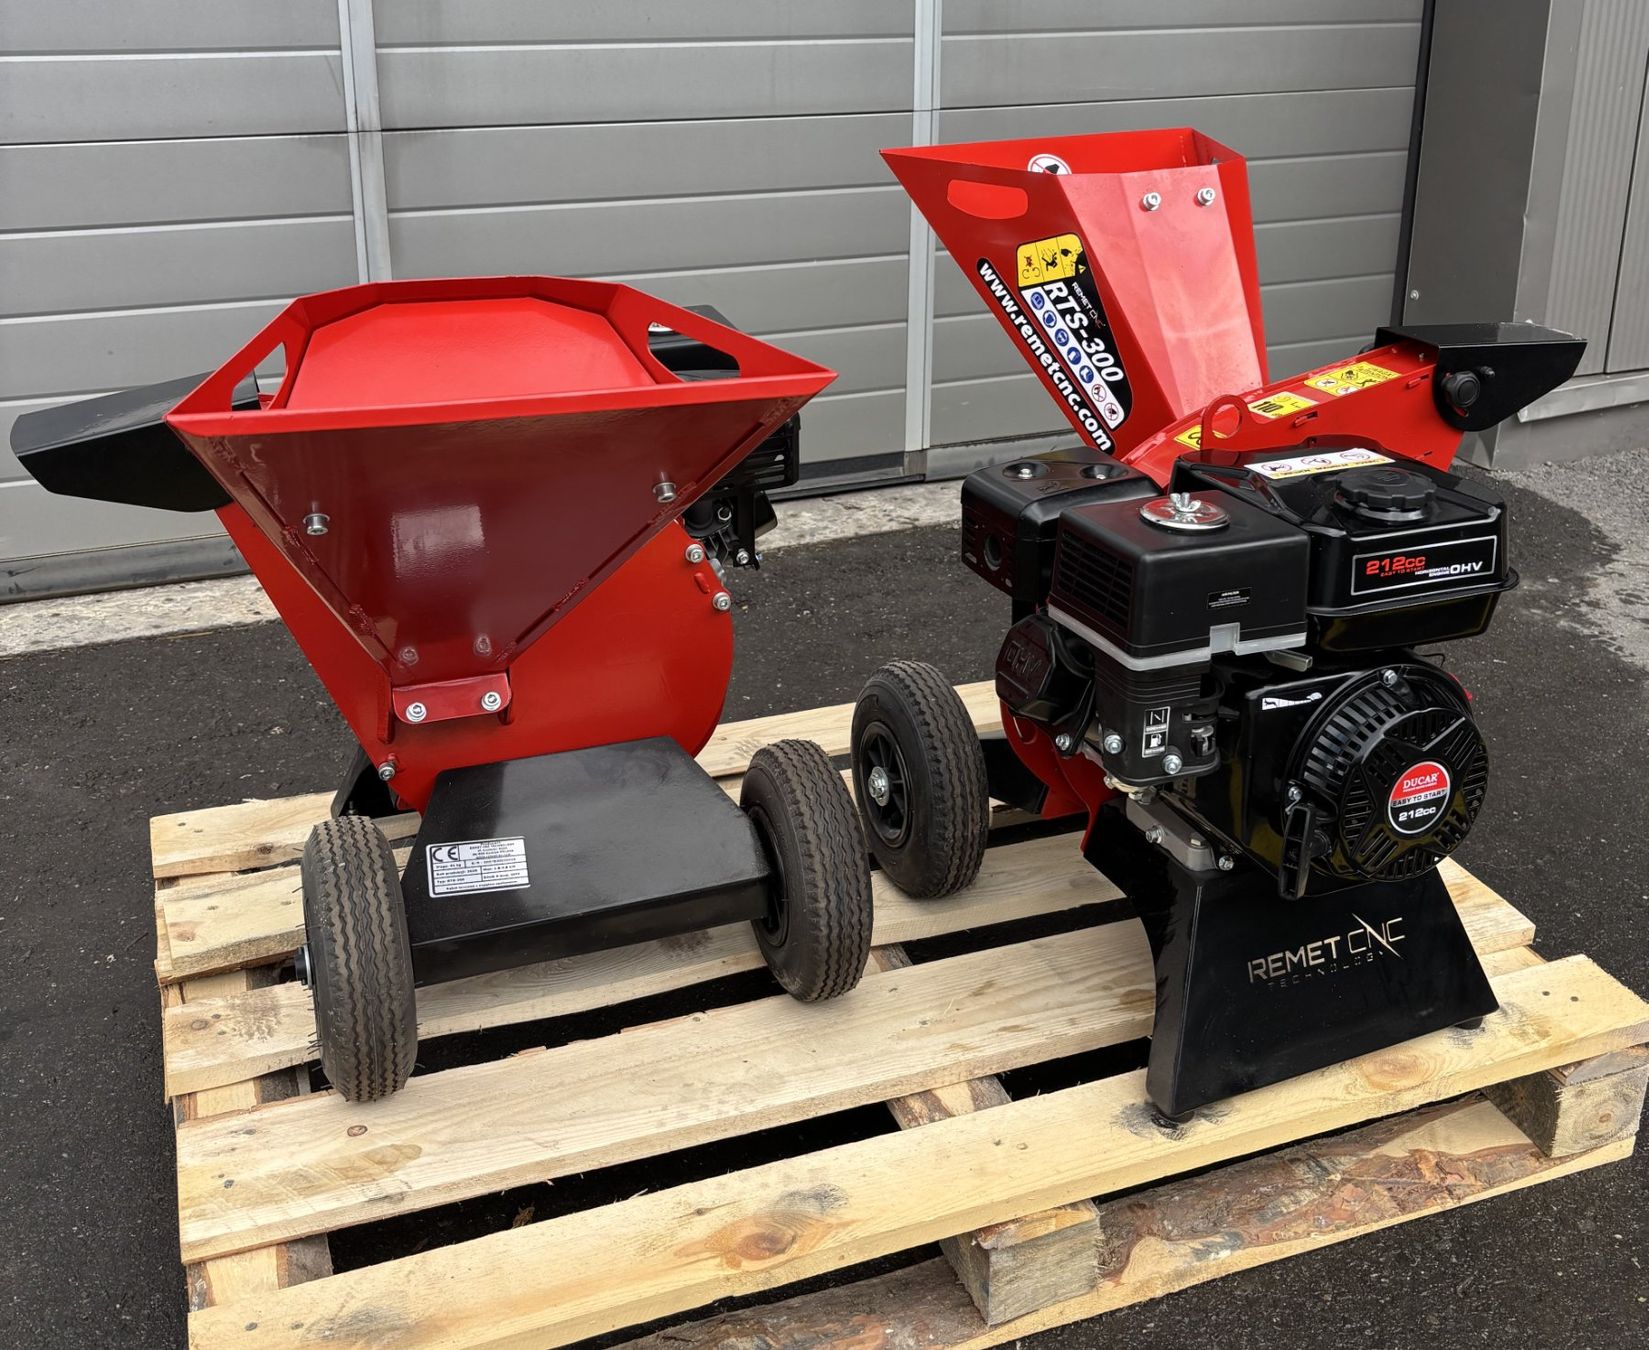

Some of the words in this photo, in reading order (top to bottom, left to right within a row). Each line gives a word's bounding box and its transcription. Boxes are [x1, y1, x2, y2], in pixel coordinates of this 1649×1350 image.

[1072, 281, 1093, 310] REMET
[1043, 281, 1124, 383] RTS-300
[979, 262, 1113, 451] www.remetcnc.com
[1366, 556, 1426, 575] 212cc
[1450, 561, 1483, 575] OHV
[1402, 773, 1438, 789] DUCAR
[1392, 797, 1413, 807] EASY
[1413, 794, 1423, 802] TO
[1423, 790, 1446, 800] START
[1398, 806, 1437, 822] 212cc
[1247, 935, 1341, 984] REMET
[1348, 913, 1405, 960] CNC
